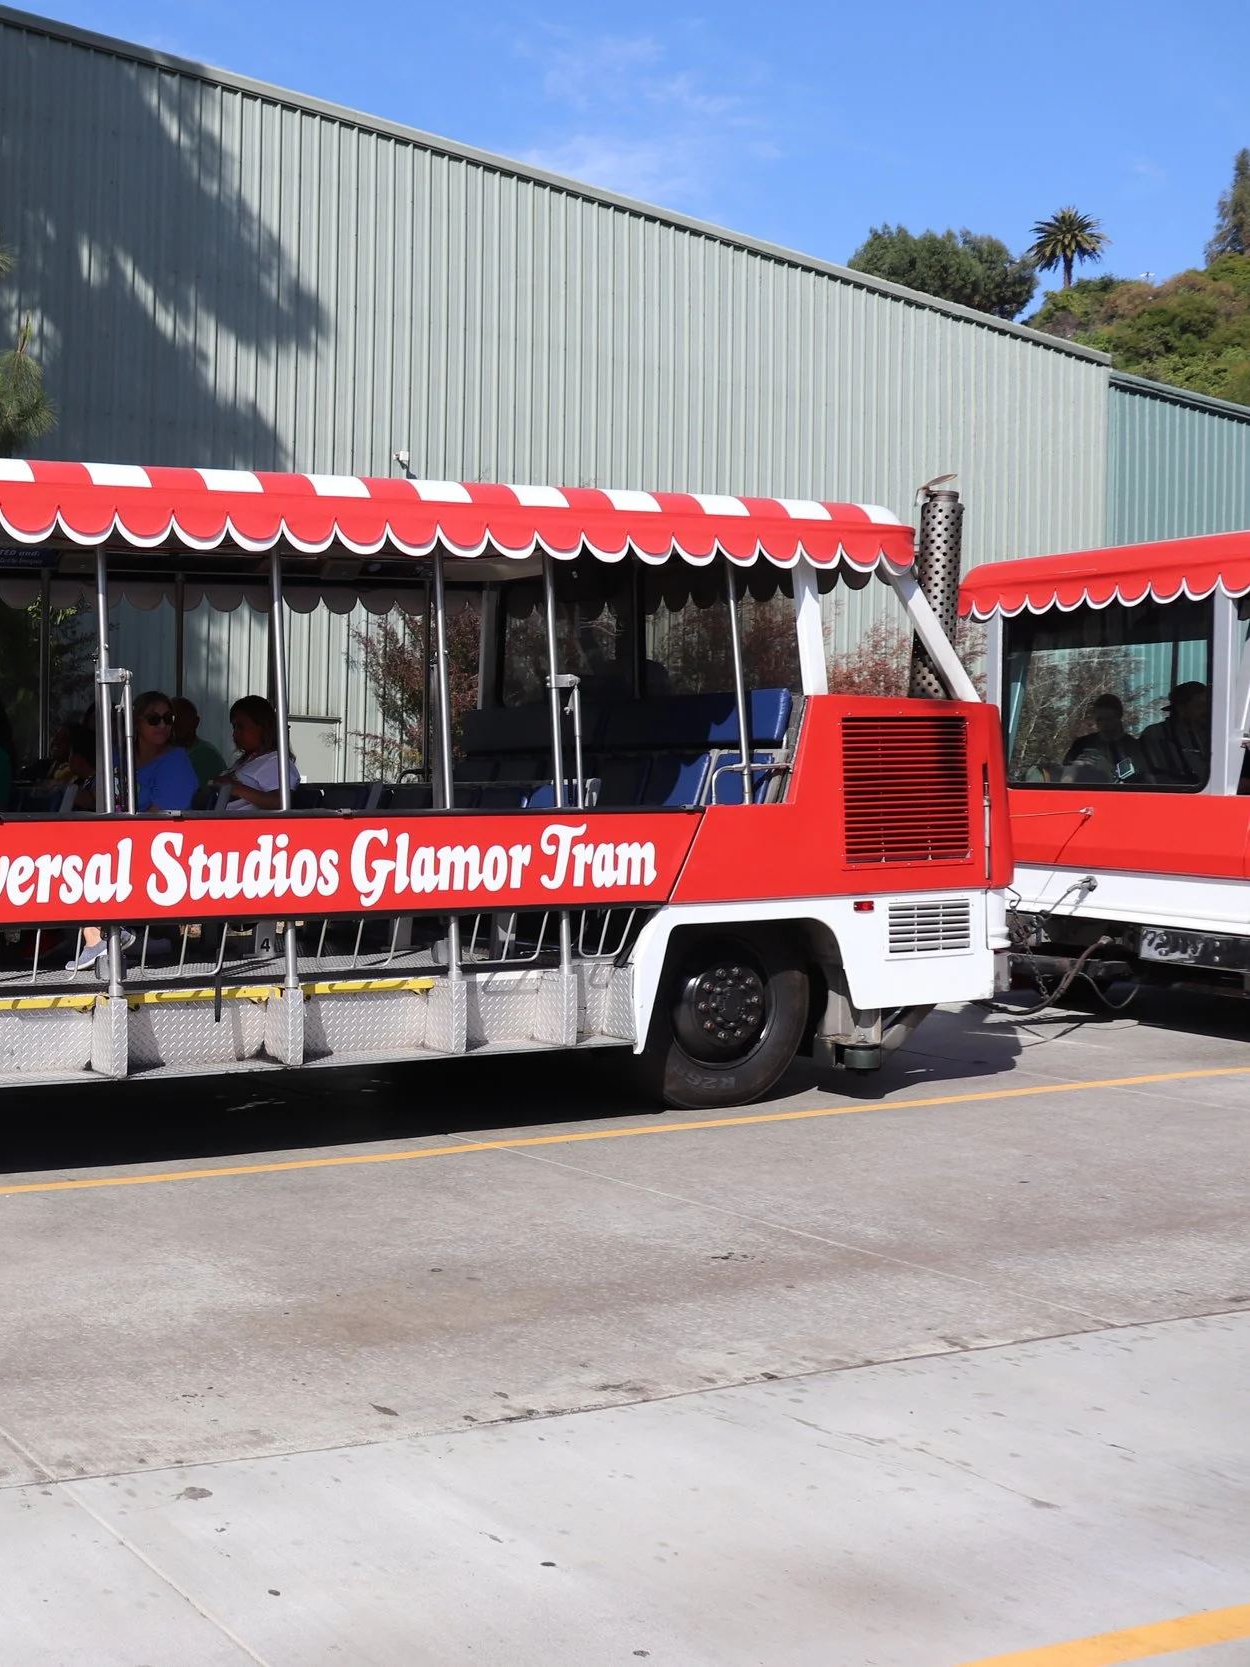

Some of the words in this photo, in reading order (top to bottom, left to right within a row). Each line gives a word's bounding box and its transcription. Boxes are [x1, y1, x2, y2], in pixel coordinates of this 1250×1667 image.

[147, 832, 340, 907] Studios
[350, 828, 532, 908] Glamor
[539, 823, 658, 890] Tram
[260, 937, 271, 952] 4
